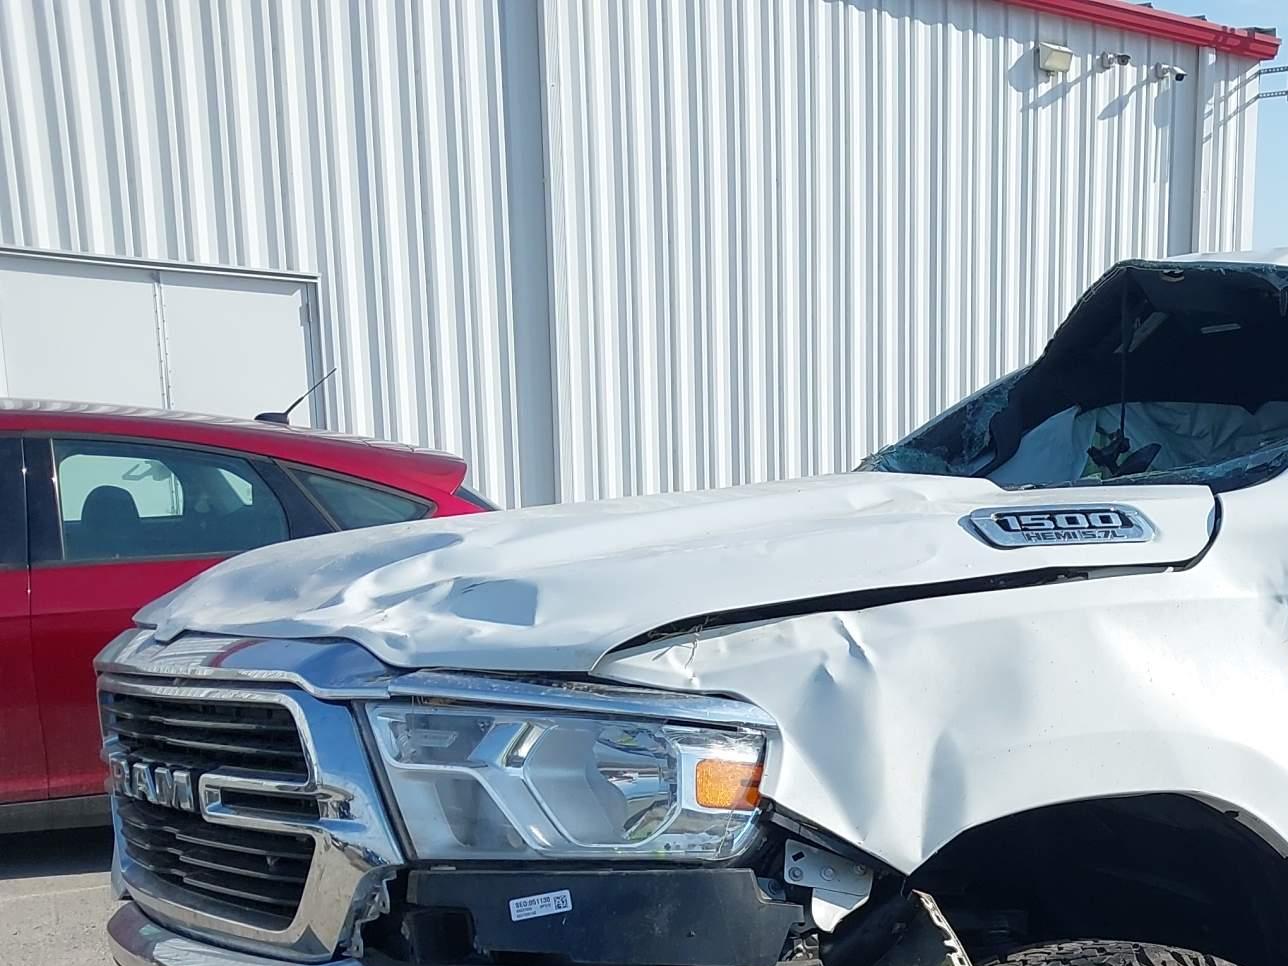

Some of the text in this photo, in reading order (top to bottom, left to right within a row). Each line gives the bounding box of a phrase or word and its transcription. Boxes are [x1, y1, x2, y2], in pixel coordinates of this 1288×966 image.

[999, 512, 1122, 531] 1500
[1026, 530, 1125, 542] HEMI 5.7L
[110, 757, 194, 811] RAM
